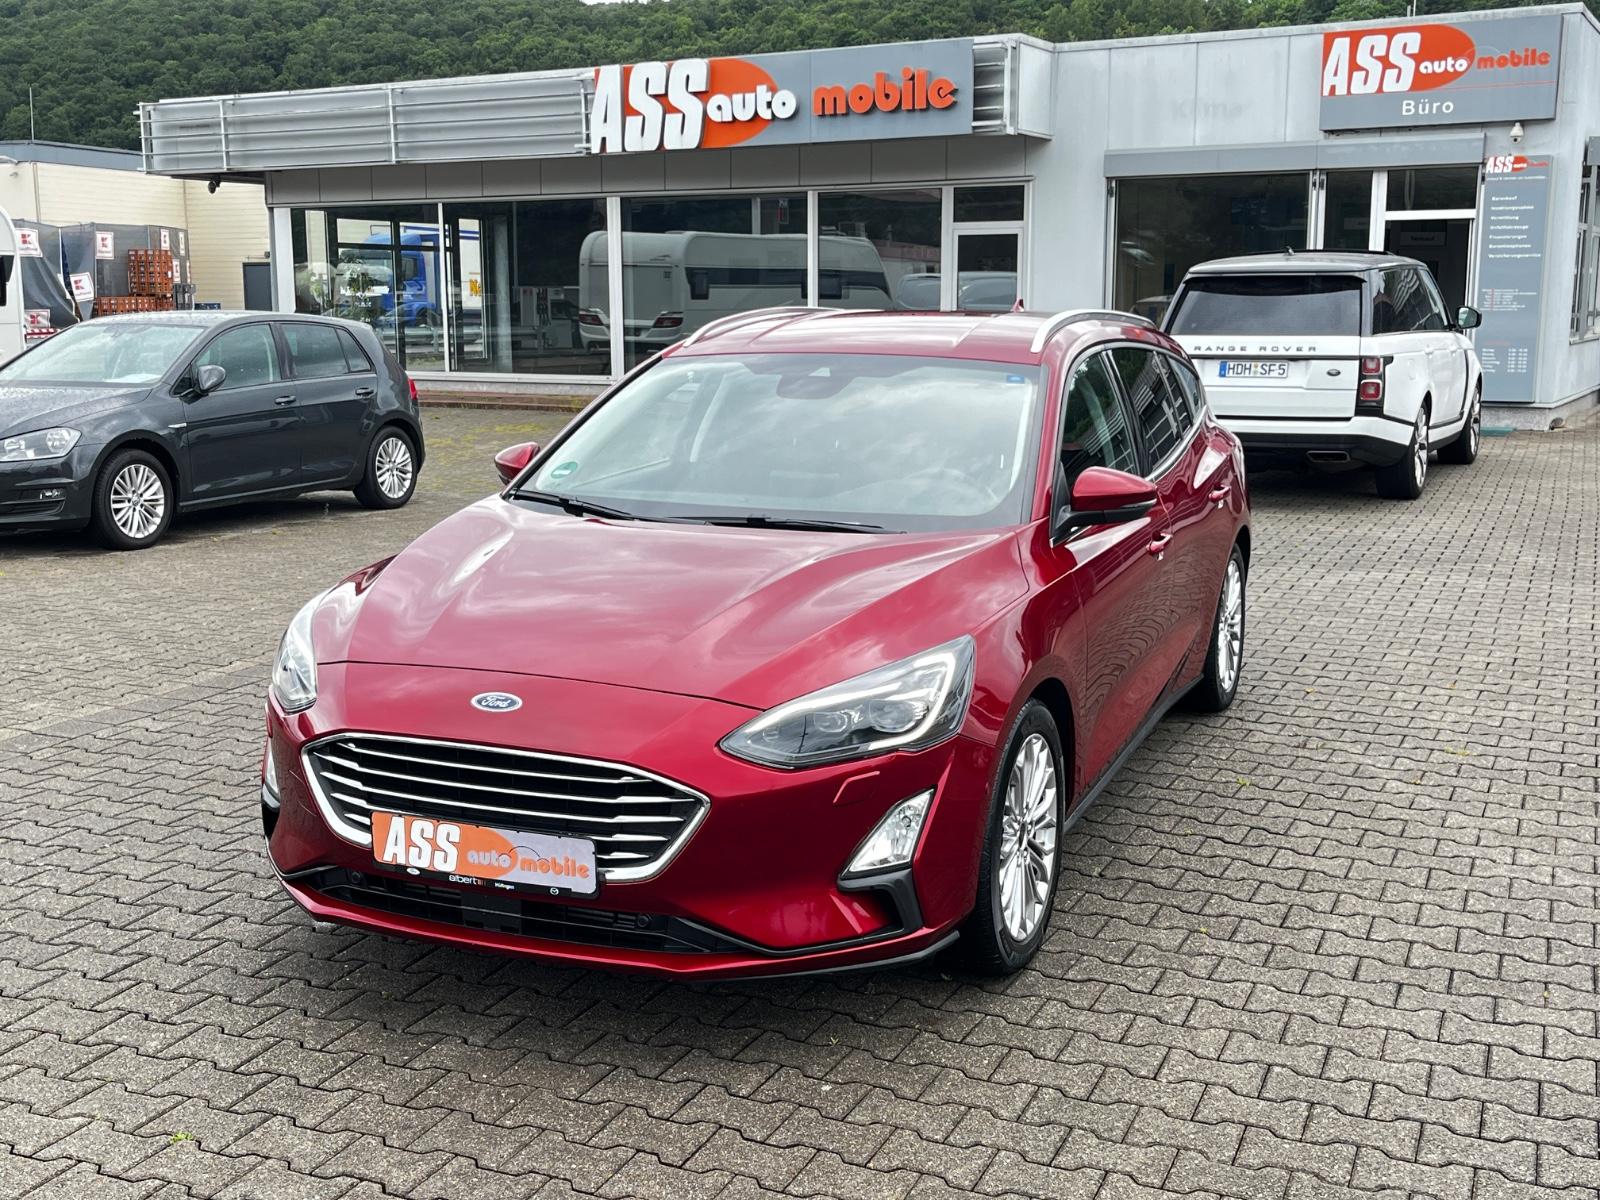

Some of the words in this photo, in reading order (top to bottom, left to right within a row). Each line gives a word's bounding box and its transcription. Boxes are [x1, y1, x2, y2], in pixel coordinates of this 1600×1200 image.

[1323, 32, 1421, 96] ASS
[1419, 56, 1469, 75] auto
[1476, 48, 1551, 71] mobile
[591, 58, 710, 154] ASS
[706, 84, 798, 123] auto
[813, 66, 958, 117] mobile
[1402, 99, 1454, 116] Büro
[1486, 156, 1514, 173] ASS
[1227, 363, 1252, 375] HDH
[481, 695, 511, 708] Ford
[383, 816, 461, 873] ASS
[467, 849, 512, 867] auto
[520, 855, 590, 879] mobile
